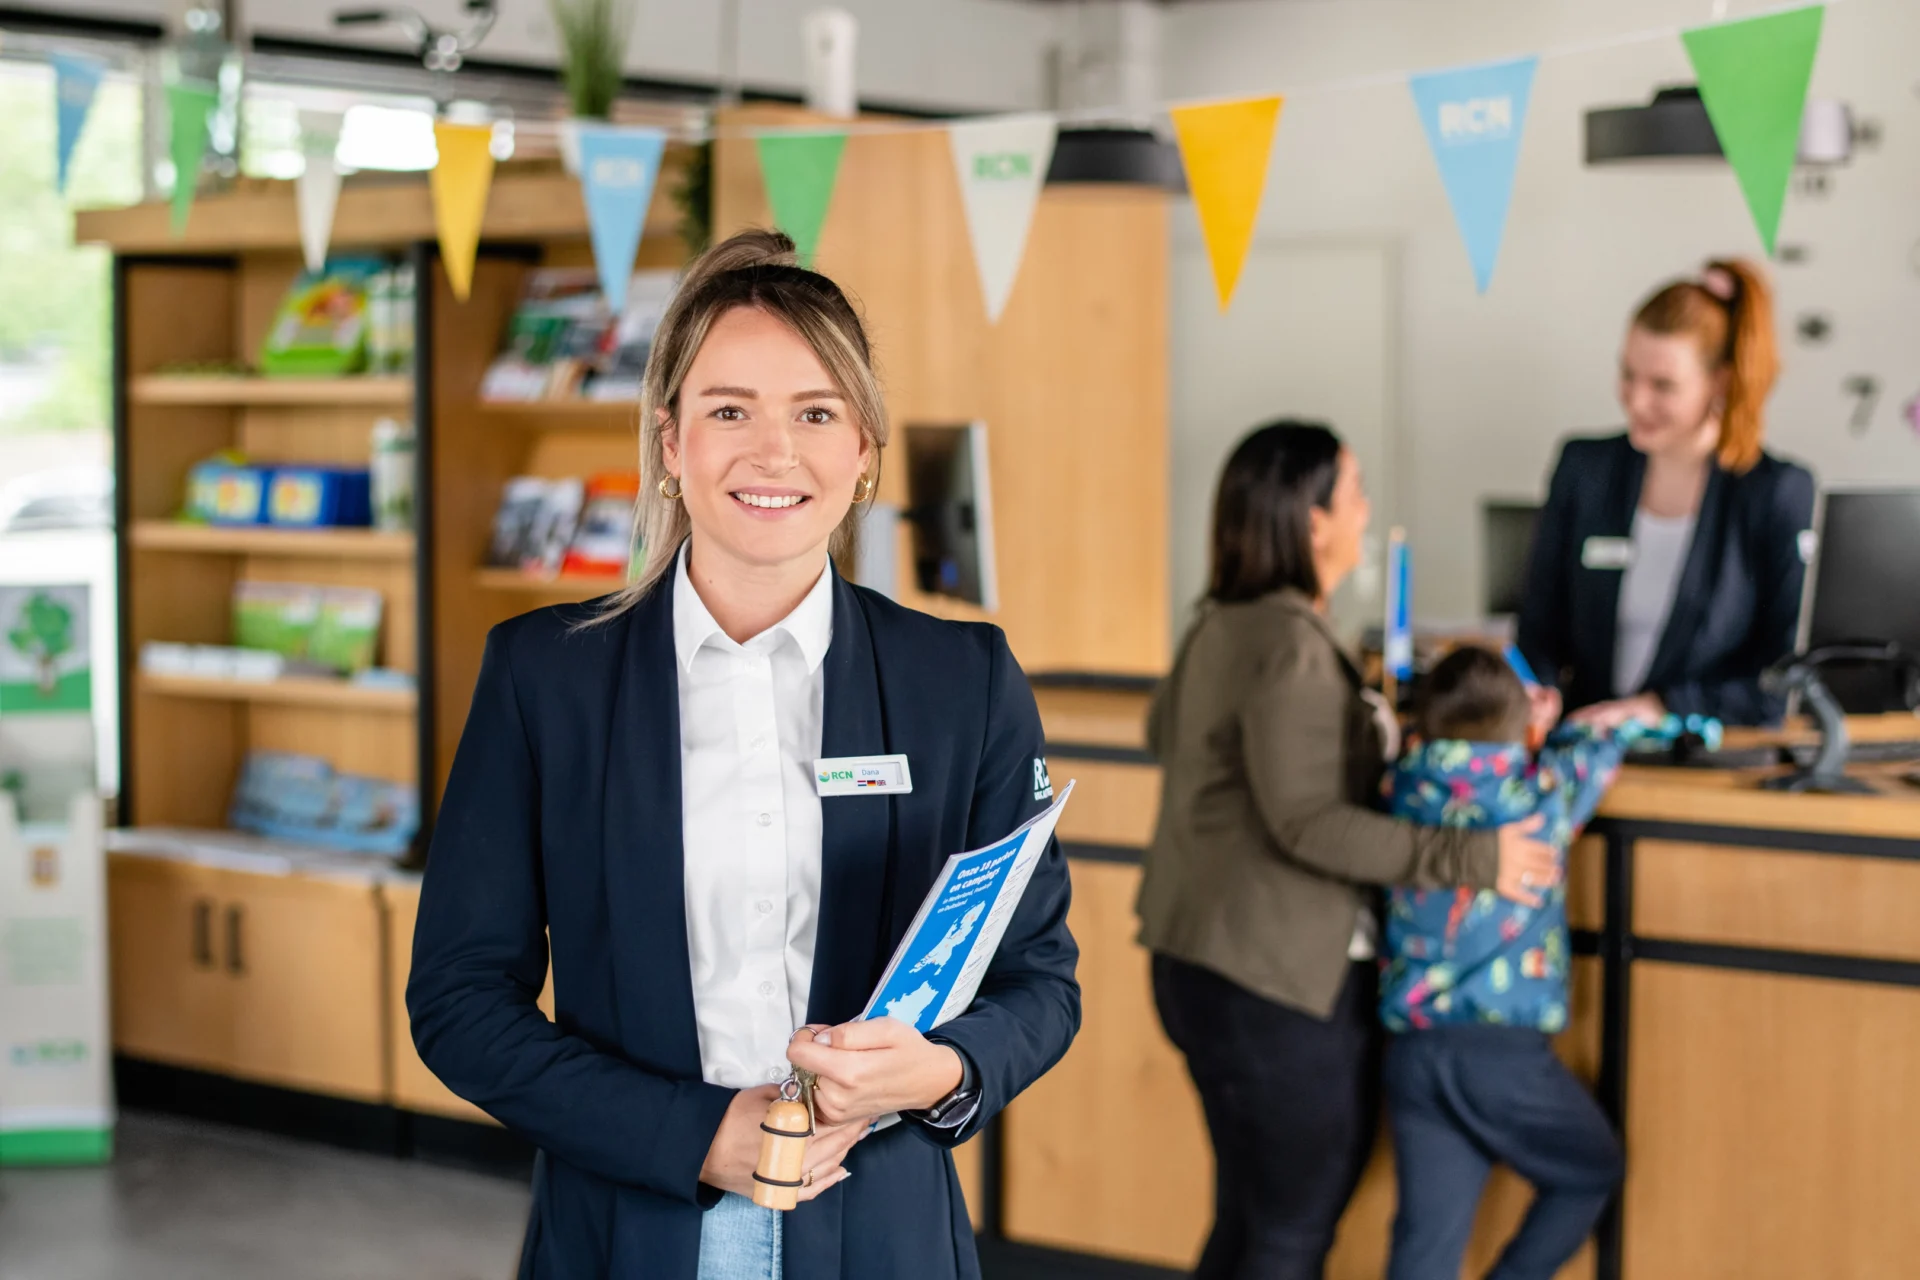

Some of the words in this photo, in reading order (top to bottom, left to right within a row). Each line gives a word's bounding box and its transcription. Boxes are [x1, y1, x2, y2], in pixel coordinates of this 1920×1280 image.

[1439, 97, 1511, 136] RCN
[973, 152, 1031, 180] RCN
[831, 770, 854, 780] RCN
[861, 768, 880, 776] Dana
[957, 866, 980, 880] Onze
[980, 860, 992, 872] 18
[990, 848, 1017, 869] parken
[949, 883, 962, 893] en
[962, 867, 1001, 889] campings
